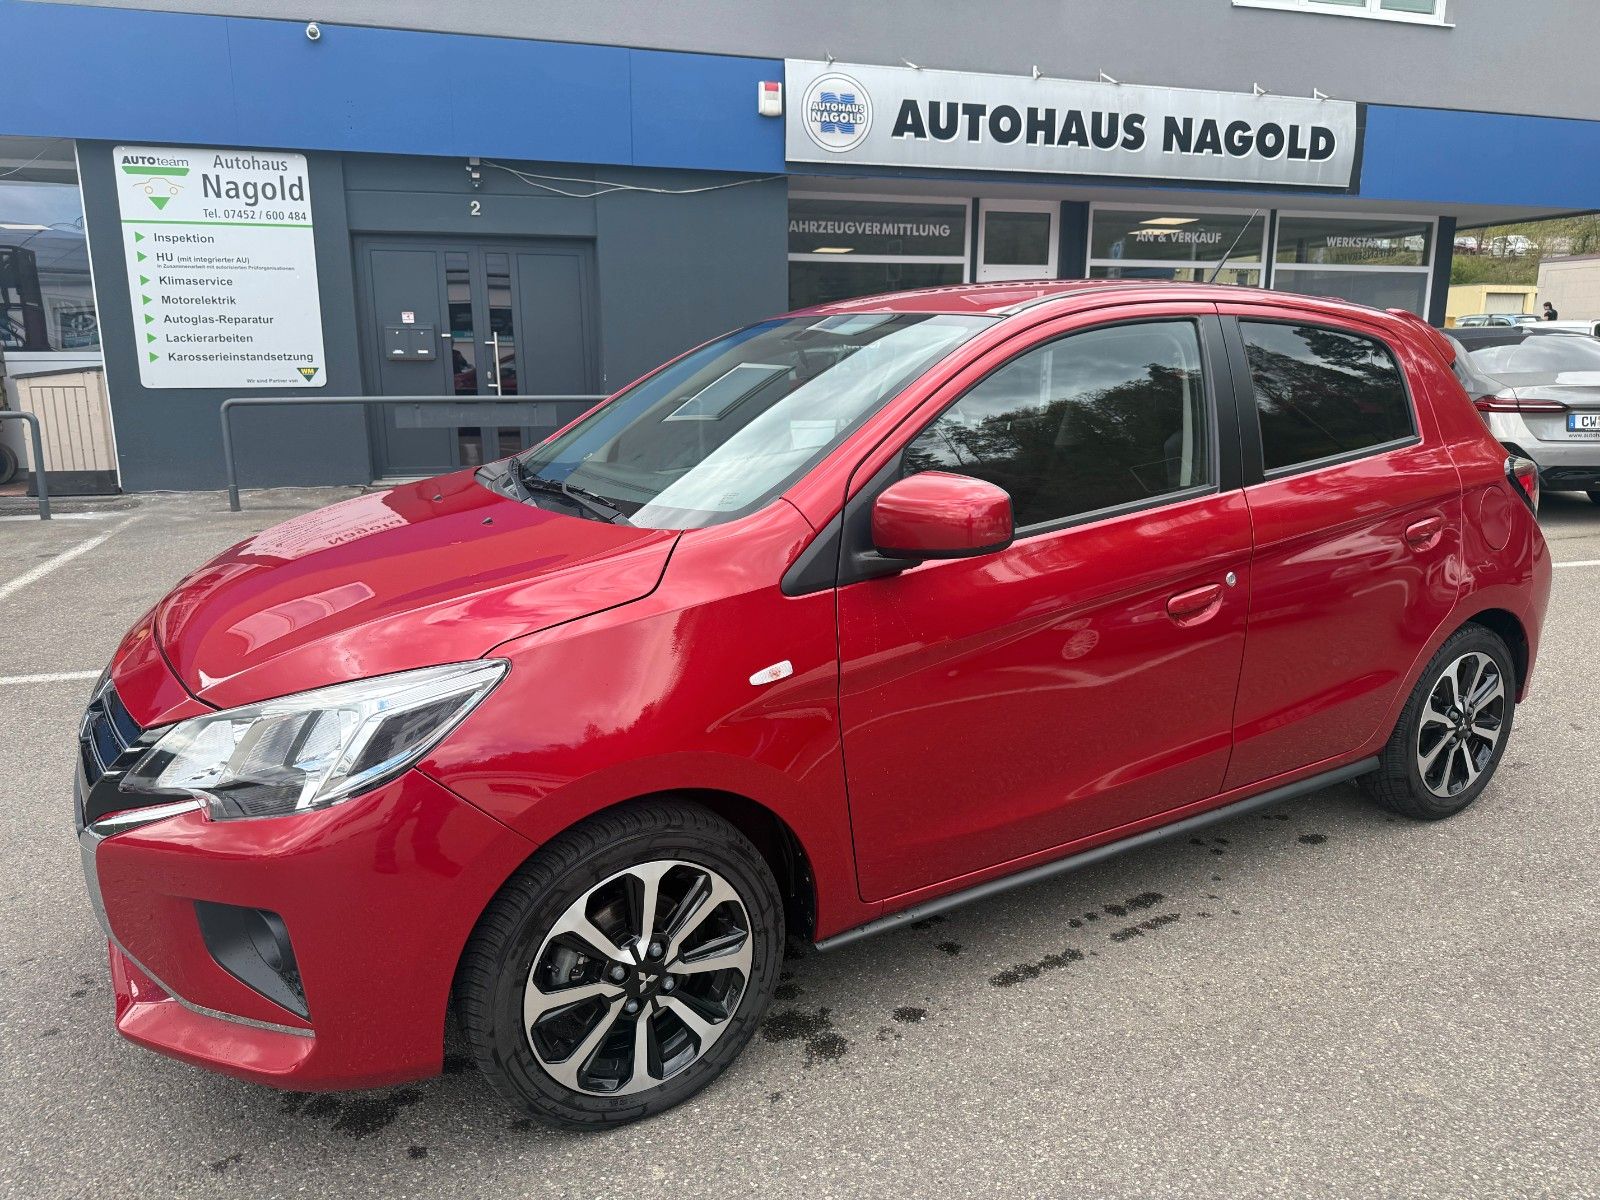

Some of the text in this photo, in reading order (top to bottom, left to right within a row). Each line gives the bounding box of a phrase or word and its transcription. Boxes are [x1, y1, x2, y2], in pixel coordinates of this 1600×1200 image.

[811, 101, 865, 113] AUTOHAUS
[811, 110, 866, 124] NAGOLD
[891, 99, 1338, 162] AUTOHAUS NAGOLD
[213, 154, 289, 172] Autohaus
[201, 173, 305, 207] Nagold
[202, 208, 307, 221] Tel. 07452 / 600 484
[470, 200, 481, 216] 2
[153, 232, 215, 245] Inspektion
[1136, 231, 1223, 244] AN & VERKAUF
[156, 252, 250, 266] HU (mit integrierter AU)
[158, 275, 233, 286] Klimaservice
[161, 295, 237, 305] Motorelektrik
[163, 314, 274, 326] Autoglas-Reparatur
[165, 333, 254, 343] Lackierarbeiten
[167, 352, 314, 363] Karosserieinstandsetzung
